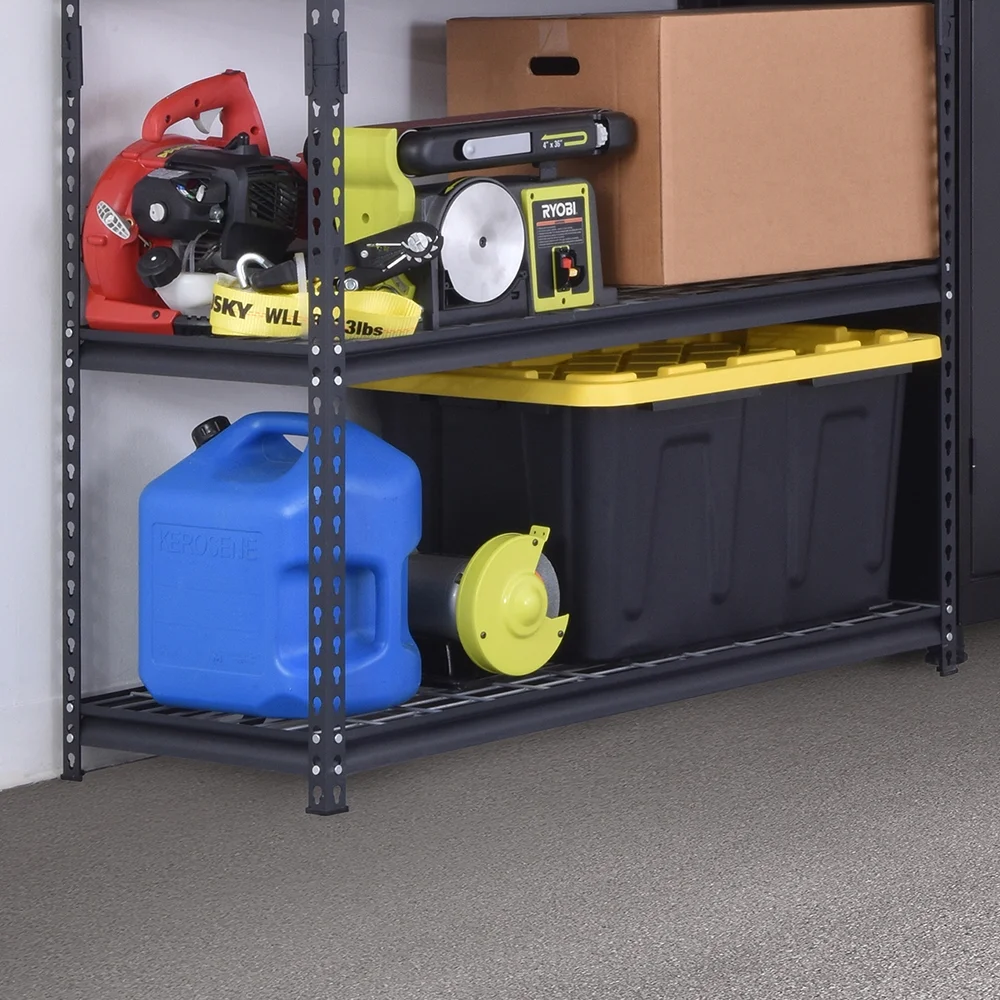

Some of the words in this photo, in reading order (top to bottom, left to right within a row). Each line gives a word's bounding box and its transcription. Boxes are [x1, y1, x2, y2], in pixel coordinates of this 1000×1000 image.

[541, 201, 576, 218] RYOBI
[212, 294, 253, 319] SKY
[265, 306, 302, 326] WLL
[159, 530, 259, 561] KEROSENE
